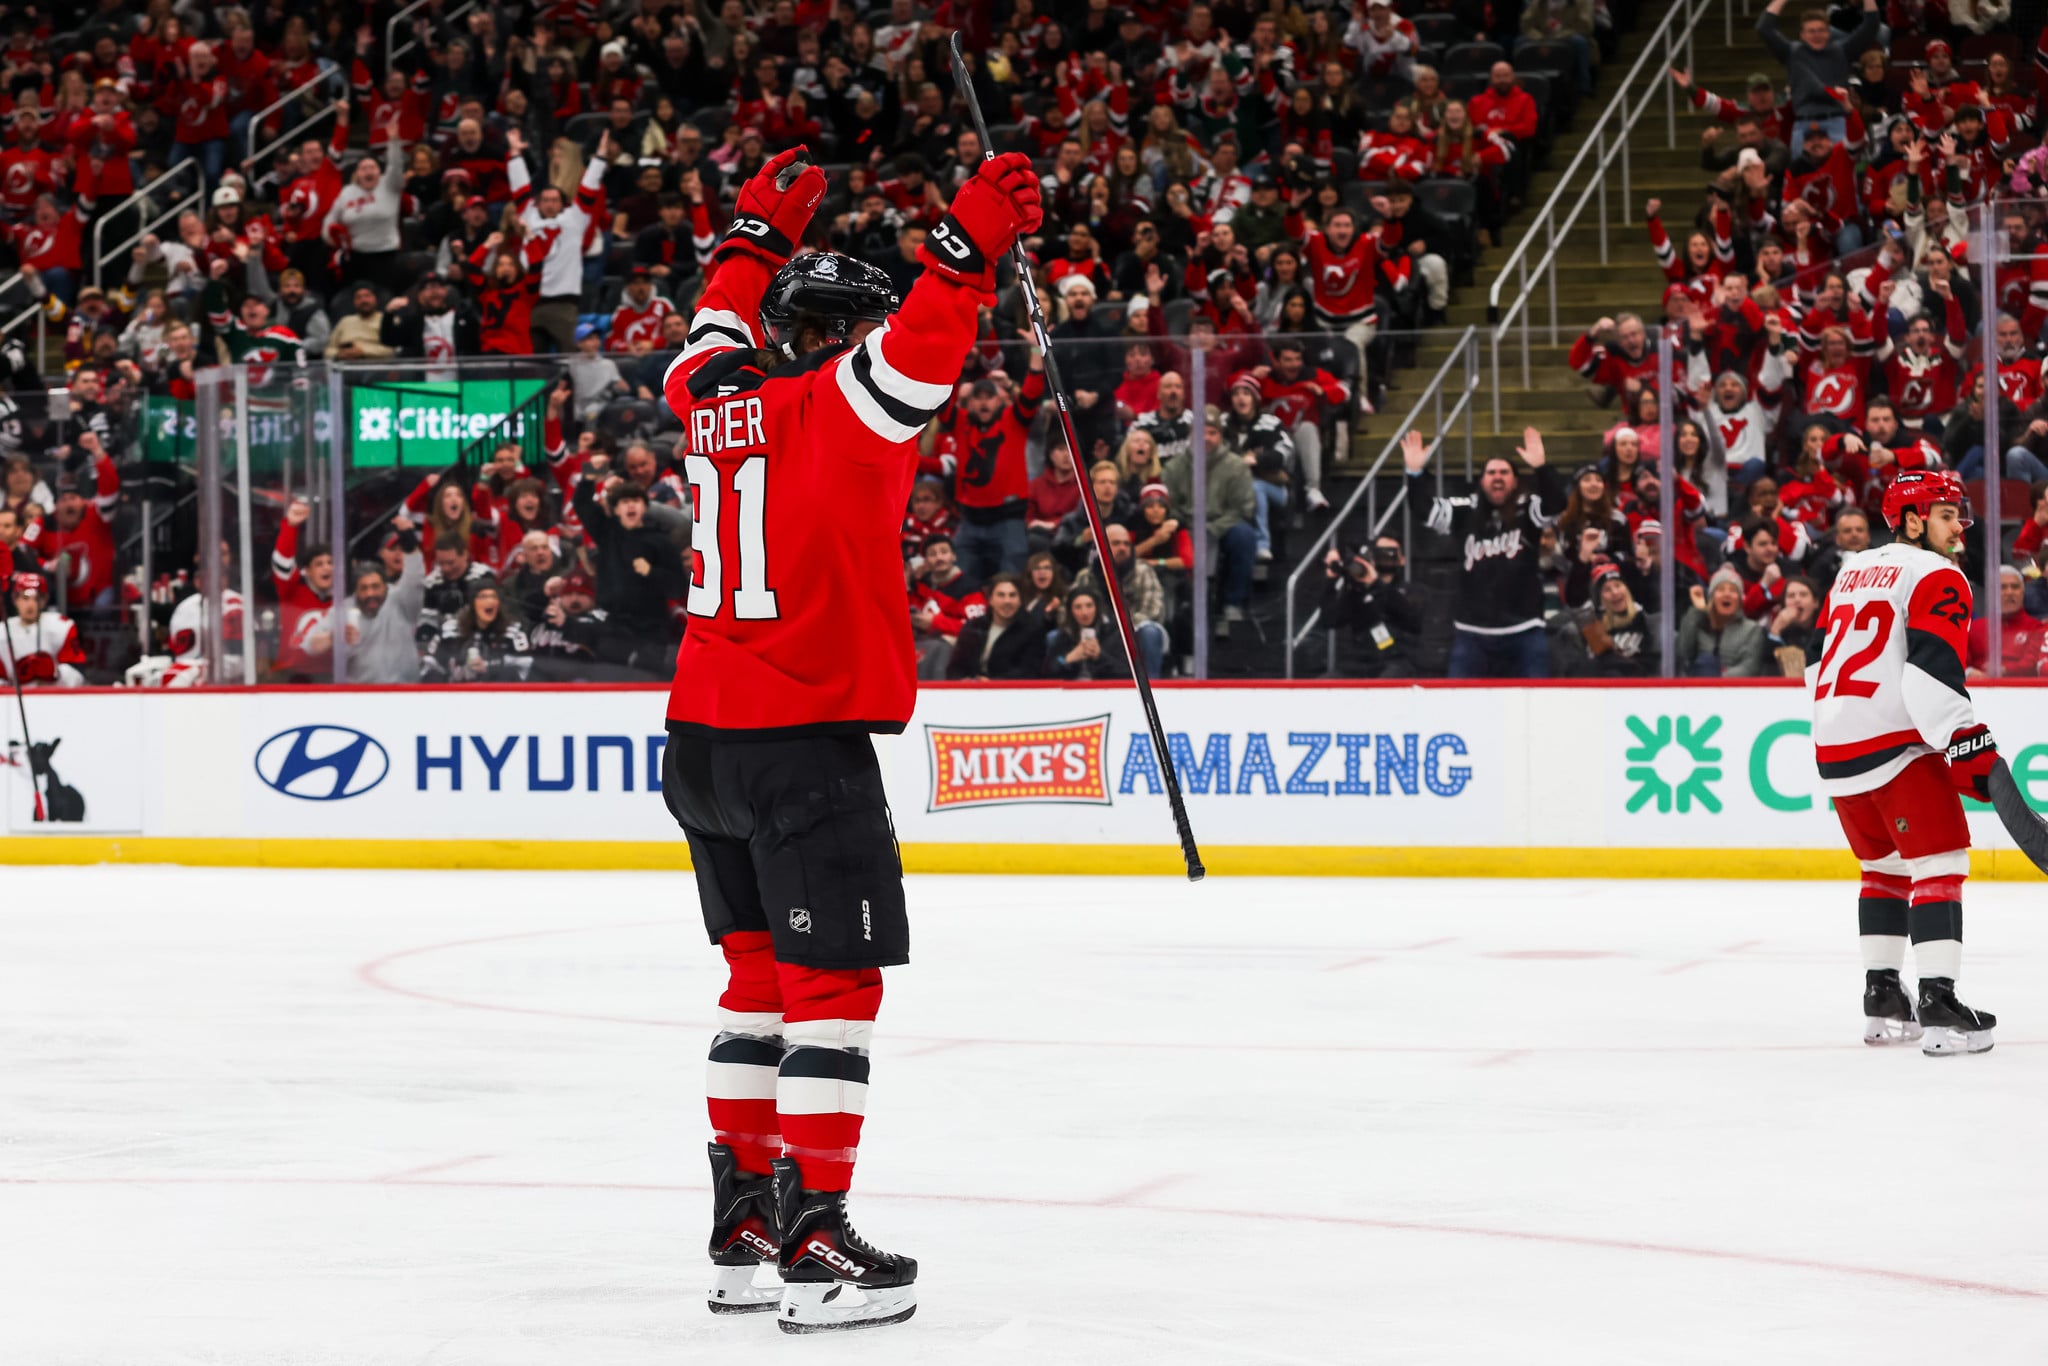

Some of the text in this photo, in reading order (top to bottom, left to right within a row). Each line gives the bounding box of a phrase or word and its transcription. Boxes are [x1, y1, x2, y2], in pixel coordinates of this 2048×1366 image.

[685, 455, 778, 620] 91
[1464, 529, 1524, 571] Jersey
[1929, 586, 1969, 629] 22
[1814, 600, 1895, 702] 22
[950, 732, 1473, 798] MIKE'S AMAZING
[861, 899, 872, 942] CCM
[741, 1229, 780, 1256] CCM
[807, 1239, 867, 1278] CCM
